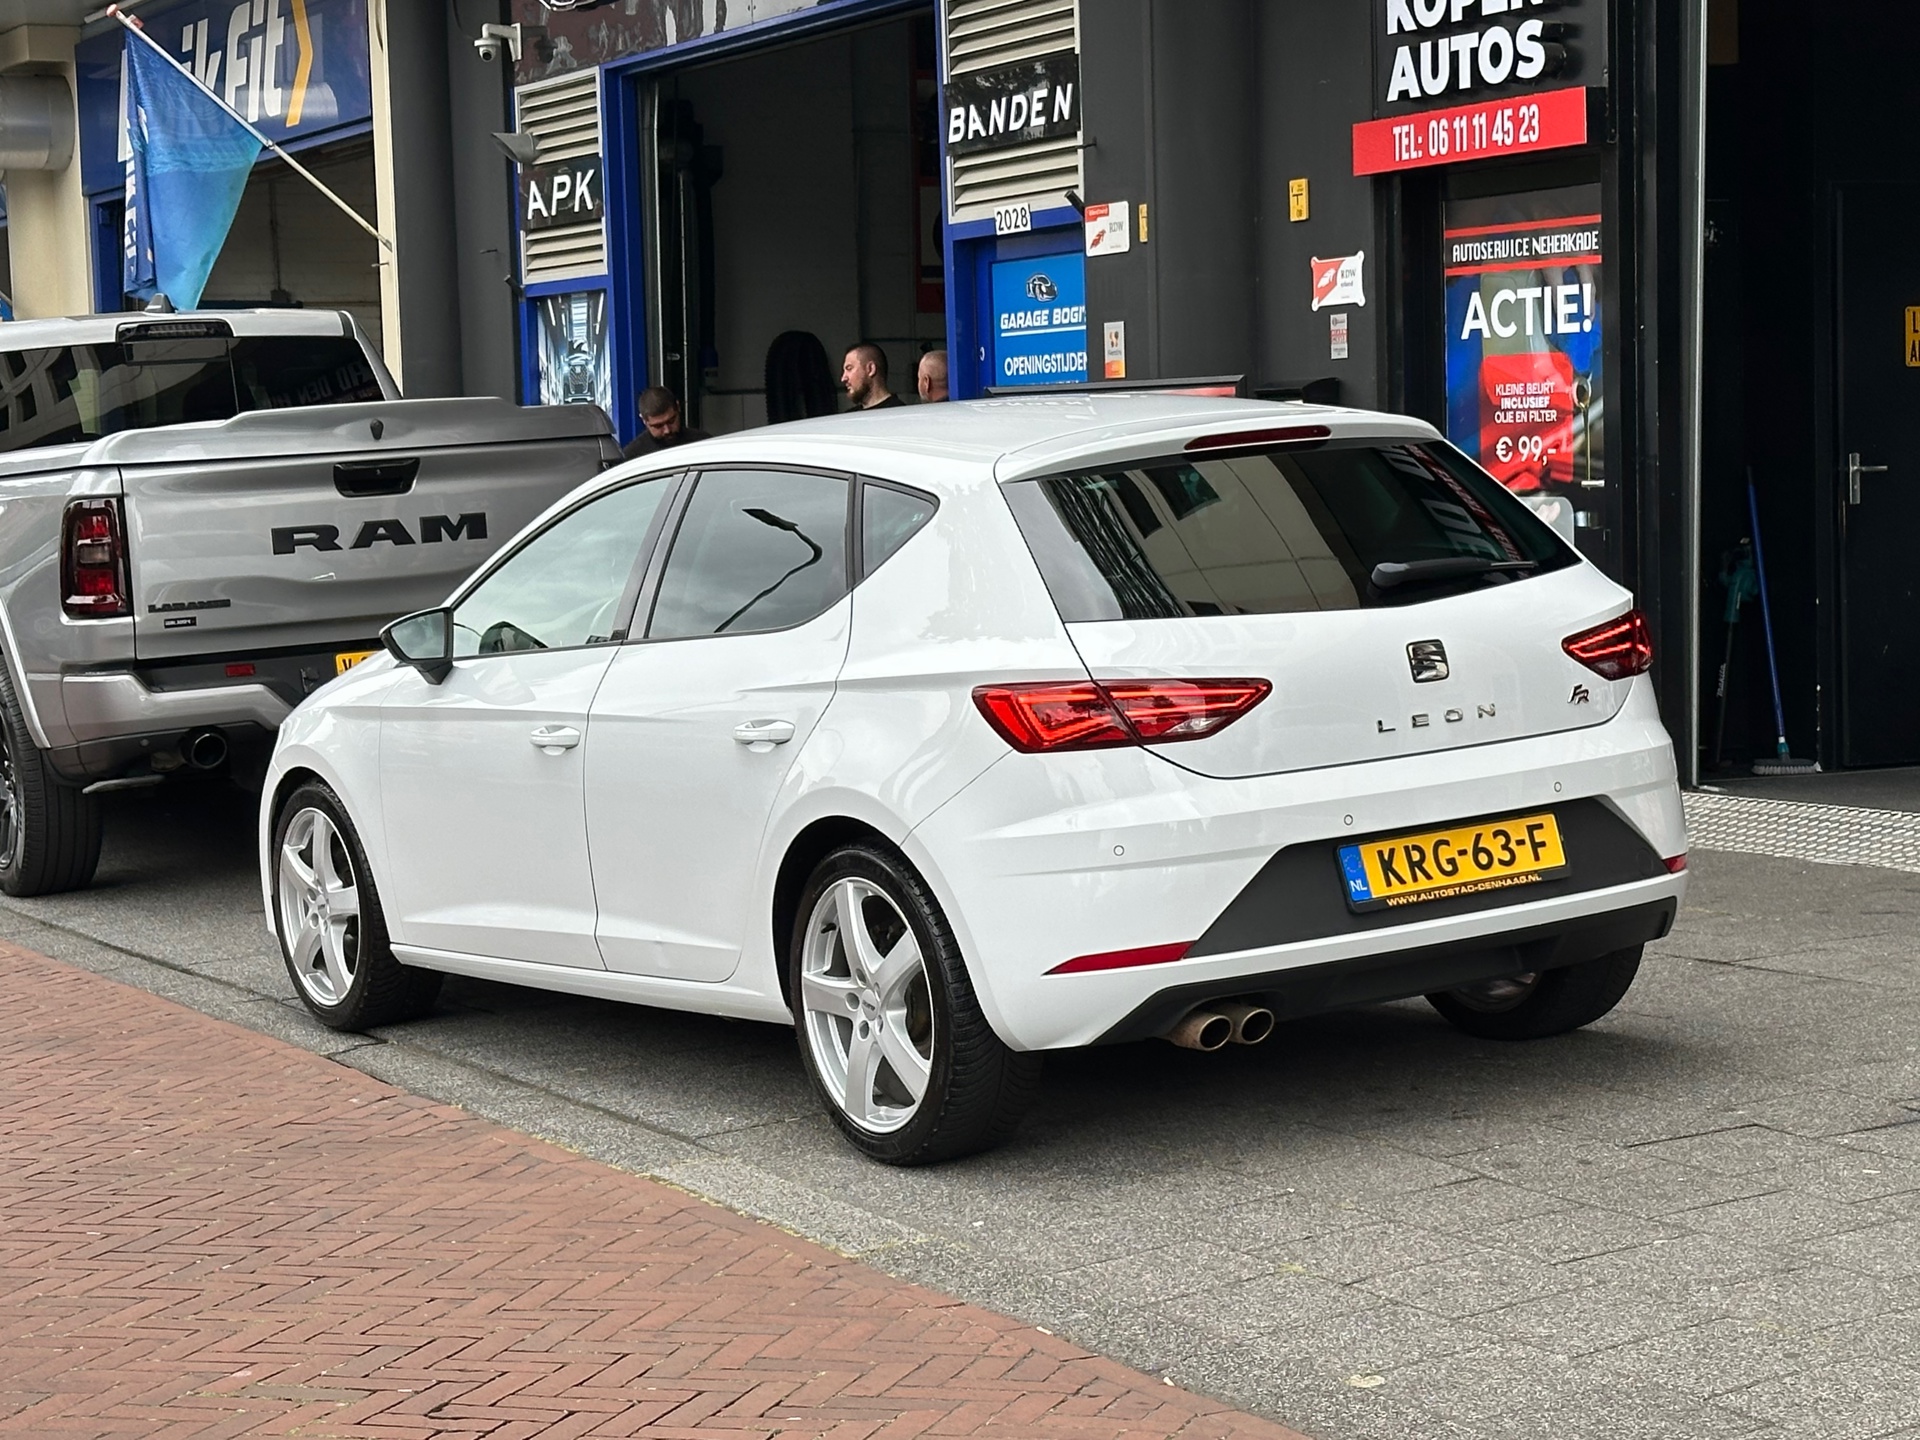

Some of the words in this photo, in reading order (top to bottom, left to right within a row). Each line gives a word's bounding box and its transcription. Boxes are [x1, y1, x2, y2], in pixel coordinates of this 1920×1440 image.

[1386, 19, 1546, 102] AUTOS
[948, 83, 1073, 144] BANDEN
[1392, 123, 1424, 162] TEL:
[1428, 117, 1449, 158] 06
[1452, 114, 1468, 153] 11
[1472, 111, 1487, 150] 11
[1491, 107, 1514, 147] 45
[1518, 103, 1540, 144] 23
[527, 168, 595, 220] APK
[996, 208, 1029, 232] 2028
[1452, 237, 1530, 263] AUTOSERVICE
[1532, 230, 1600, 257] NEHERKADE
[1000, 308, 1050, 331] GARAGE
[1460, 283, 1593, 341] ACTIE!
[1495, 383, 1524, 397] KLEINE
[1526, 381, 1556, 395] BEURT
[1500, 396, 1551, 411] INCLUSIEF
[1494, 411, 1515, 424] OLIE
[1516, 411, 1527, 424] EN
[1529, 409, 1557, 423] FILTER
[1495, 436, 1514, 463] €
[1517, 435, 1557, 466] 99,-
[271, 512, 488, 556] RAM
[1377, 703, 1496, 734] LEON
[1376, 822, 1547, 889] KRG-63-F
[1349, 879, 1368, 893] NL
[1386, 875, 1543, 907] WWW.AUTOSTAD-DENHAAG.NL
